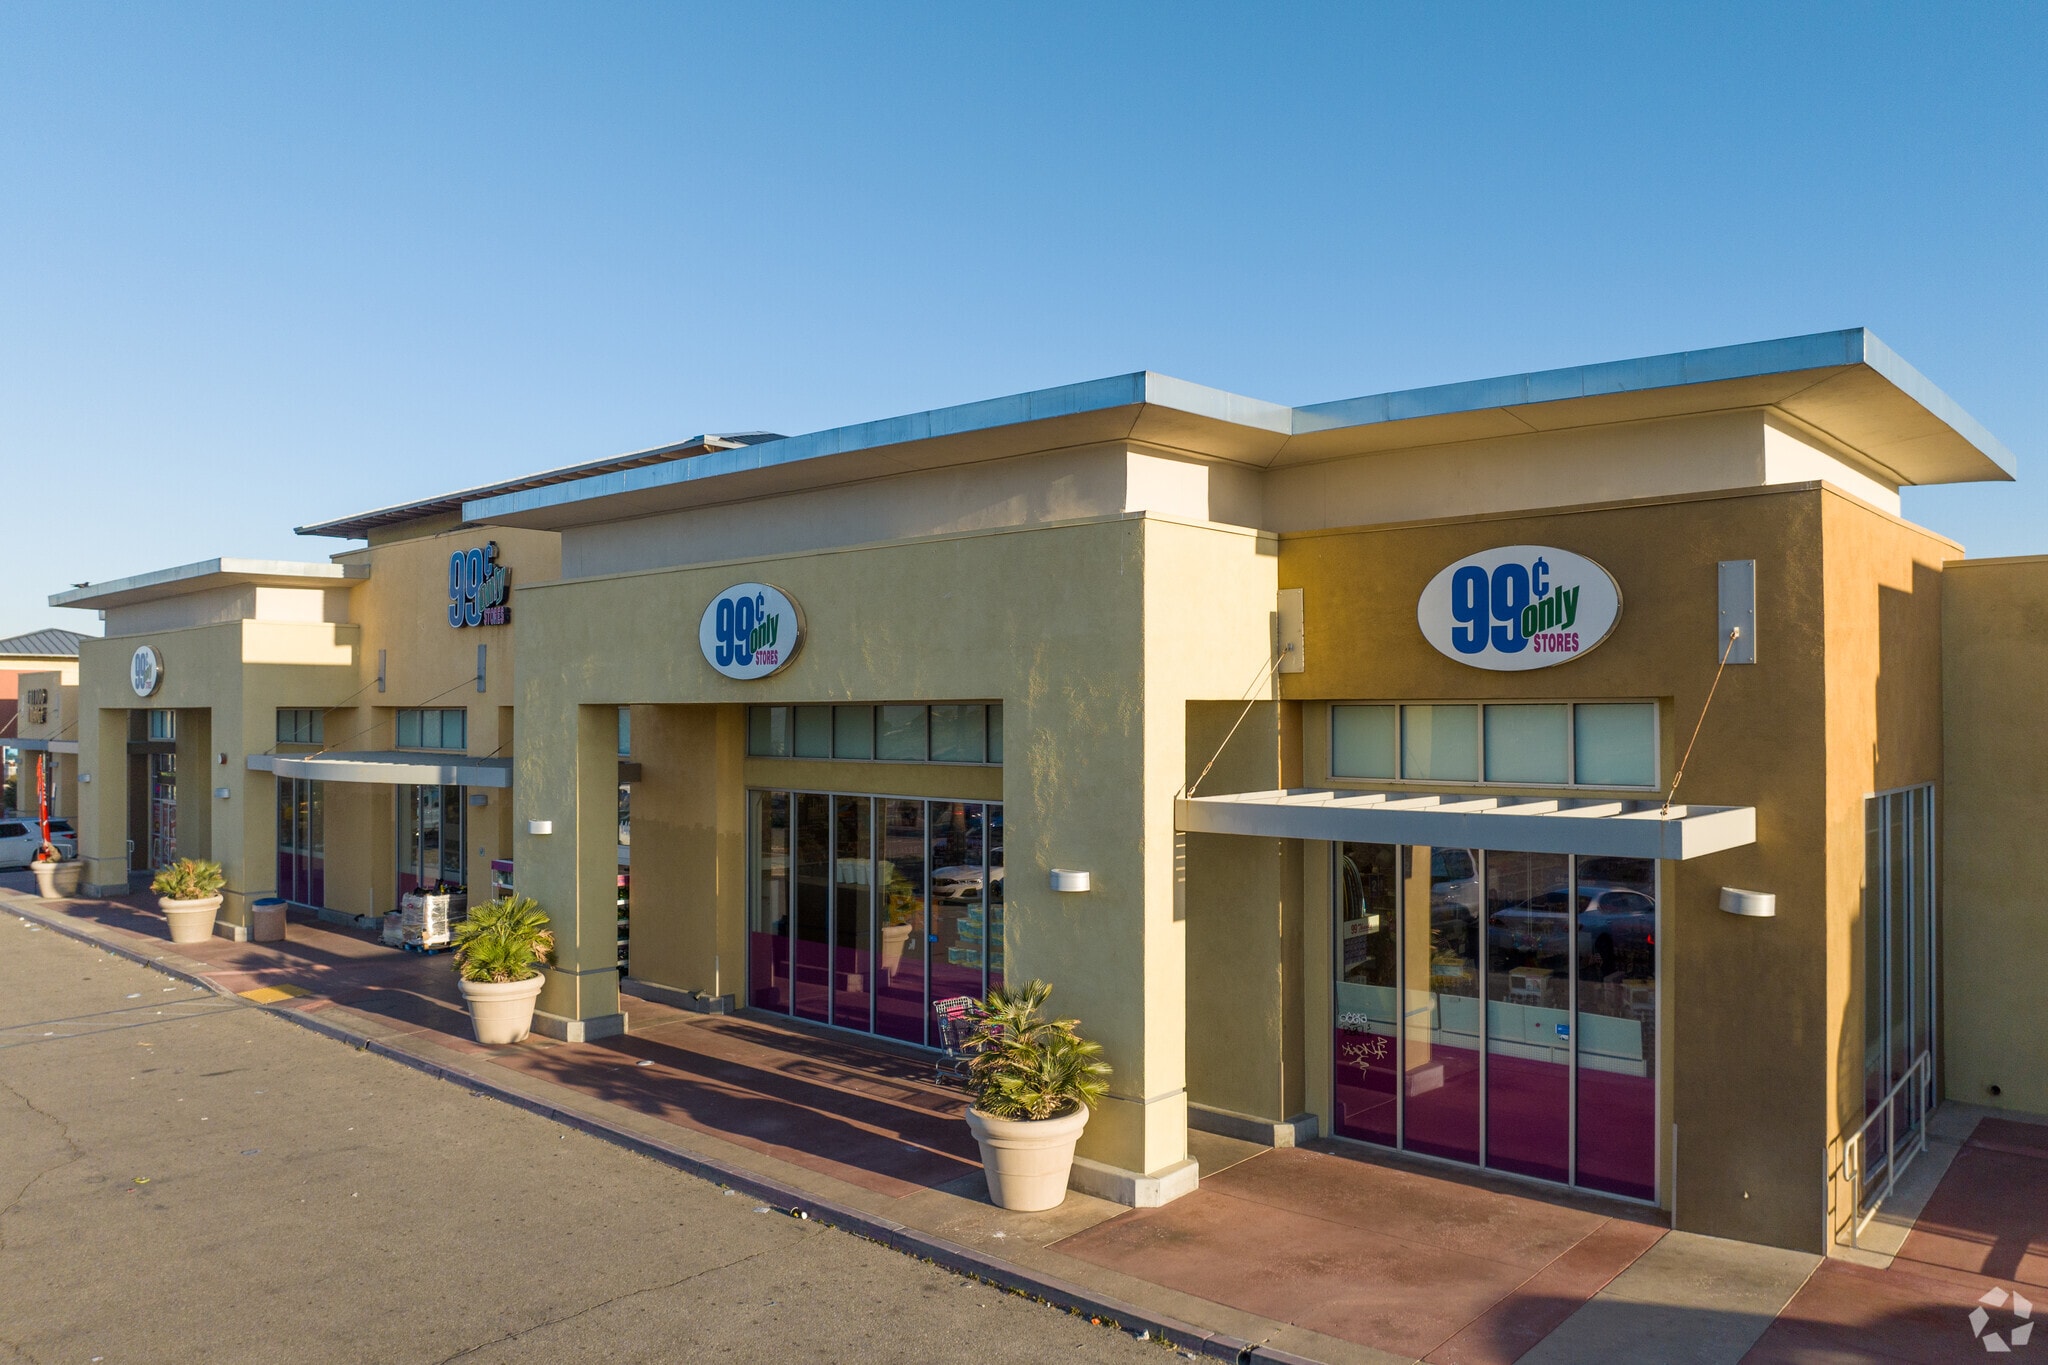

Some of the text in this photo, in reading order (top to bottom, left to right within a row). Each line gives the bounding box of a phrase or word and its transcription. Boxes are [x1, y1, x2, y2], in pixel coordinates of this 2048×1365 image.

[716, 591, 765, 667] 99¢
[1452, 557, 1550, 655] 99¢
[1522, 585, 1580, 639] only
[750, 613, 780, 655] only
[755, 649, 778, 666] STORES
[1533, 632, 1579, 653] STORES
